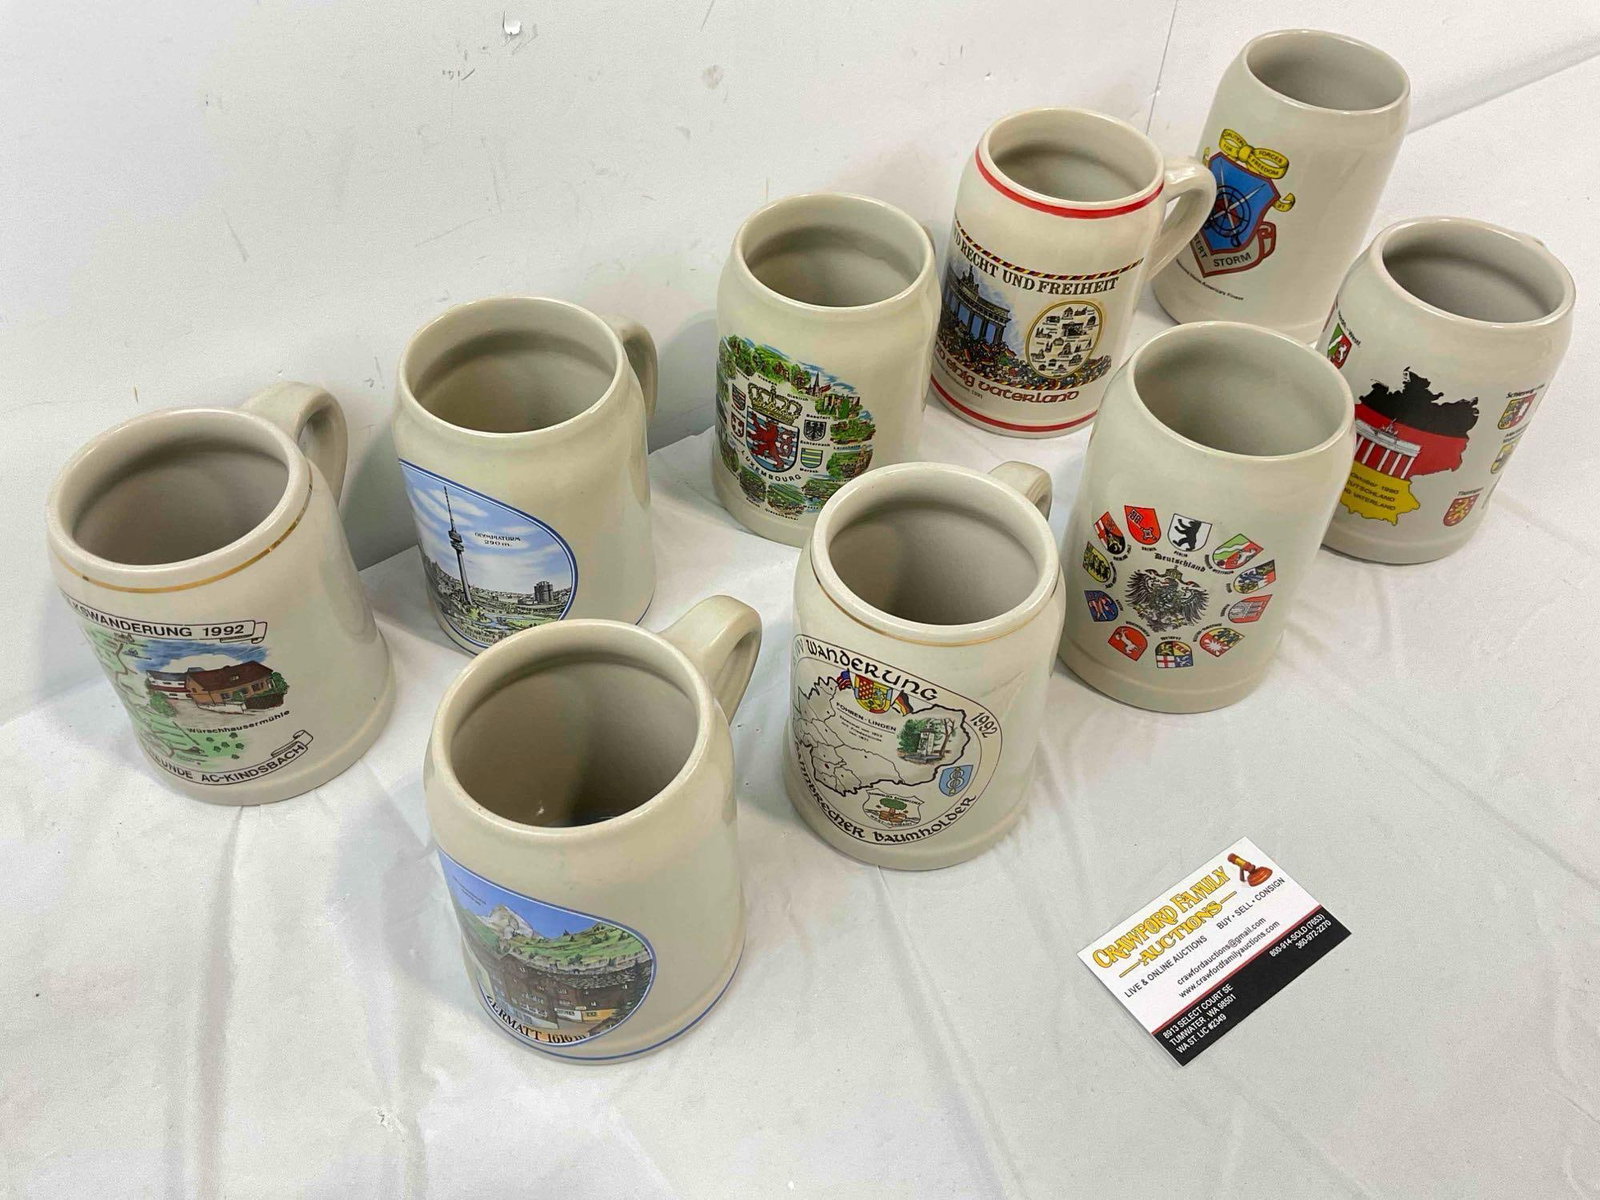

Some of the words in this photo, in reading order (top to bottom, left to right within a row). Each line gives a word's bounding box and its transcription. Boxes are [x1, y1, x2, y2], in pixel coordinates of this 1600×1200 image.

[960, 240, 999, 278] RECHT
[1002, 272, 1036, 291] UND
[1036, 277, 1120, 296] FREIHEIT
[1213, 252, 1252, 267] STORM
[741, 449, 802, 483] LUXEMBOURG
[1154, 552, 1206, 573] Deutschland
[202, 624, 245, 637] 1992
[805, 639, 938, 701] WANDERUNG
[969, 712, 998, 739] 1992
[201, 743, 305, 783] AC-KINDSBACH
[872, 794, 978, 843] BAUMHOLDER
[1092, 904, 1179, 969] CRAWFORD
[1169, 865, 1231, 914] FAMILY
[1216, 917, 1233, 931] BUY
[1234, 902, 1254, 918] SELL
[1254, 877, 1286, 902] CONSIGN
[1137, 900, 1223, 967] AUCTIONS
[1177, 917, 1267, 986] crawfordauctions@gmail.com
[1269, 926, 1309, 957] 800-914-SOLD
[1306, 913, 1326, 930] (7653)
[1295, 919, 1332, 950] 360-972-2270
[1124, 984, 1143, 998] LIVE
[1142, 978, 1149, 986] &
[1147, 958, 1174, 982] ONLINE
[1172, 935, 1208, 963] AUCTIONS
[1178, 921, 1280, 999] www.crawfordfamilyauctions.com
[485, 994, 543, 1041] ZERMATT
[546, 1033, 574, 1044] 1616
[1162, 1025, 1180, 1039] 8913
[1177, 1006, 1203, 1028] SELECT
[1200, 989, 1224, 1010] COURT
[1221, 983, 1234, 994] SE
[1168, 1016, 1207, 1046] TUMWATER
[1206, 1006, 1220, 1018] WA
[1217, 993, 1237, 1010] 98501
[1175, 1042, 1191, 1054] WA
[1196, 1026, 1210, 1039] LIC
[1207, 1013, 1227, 1031] #2349
